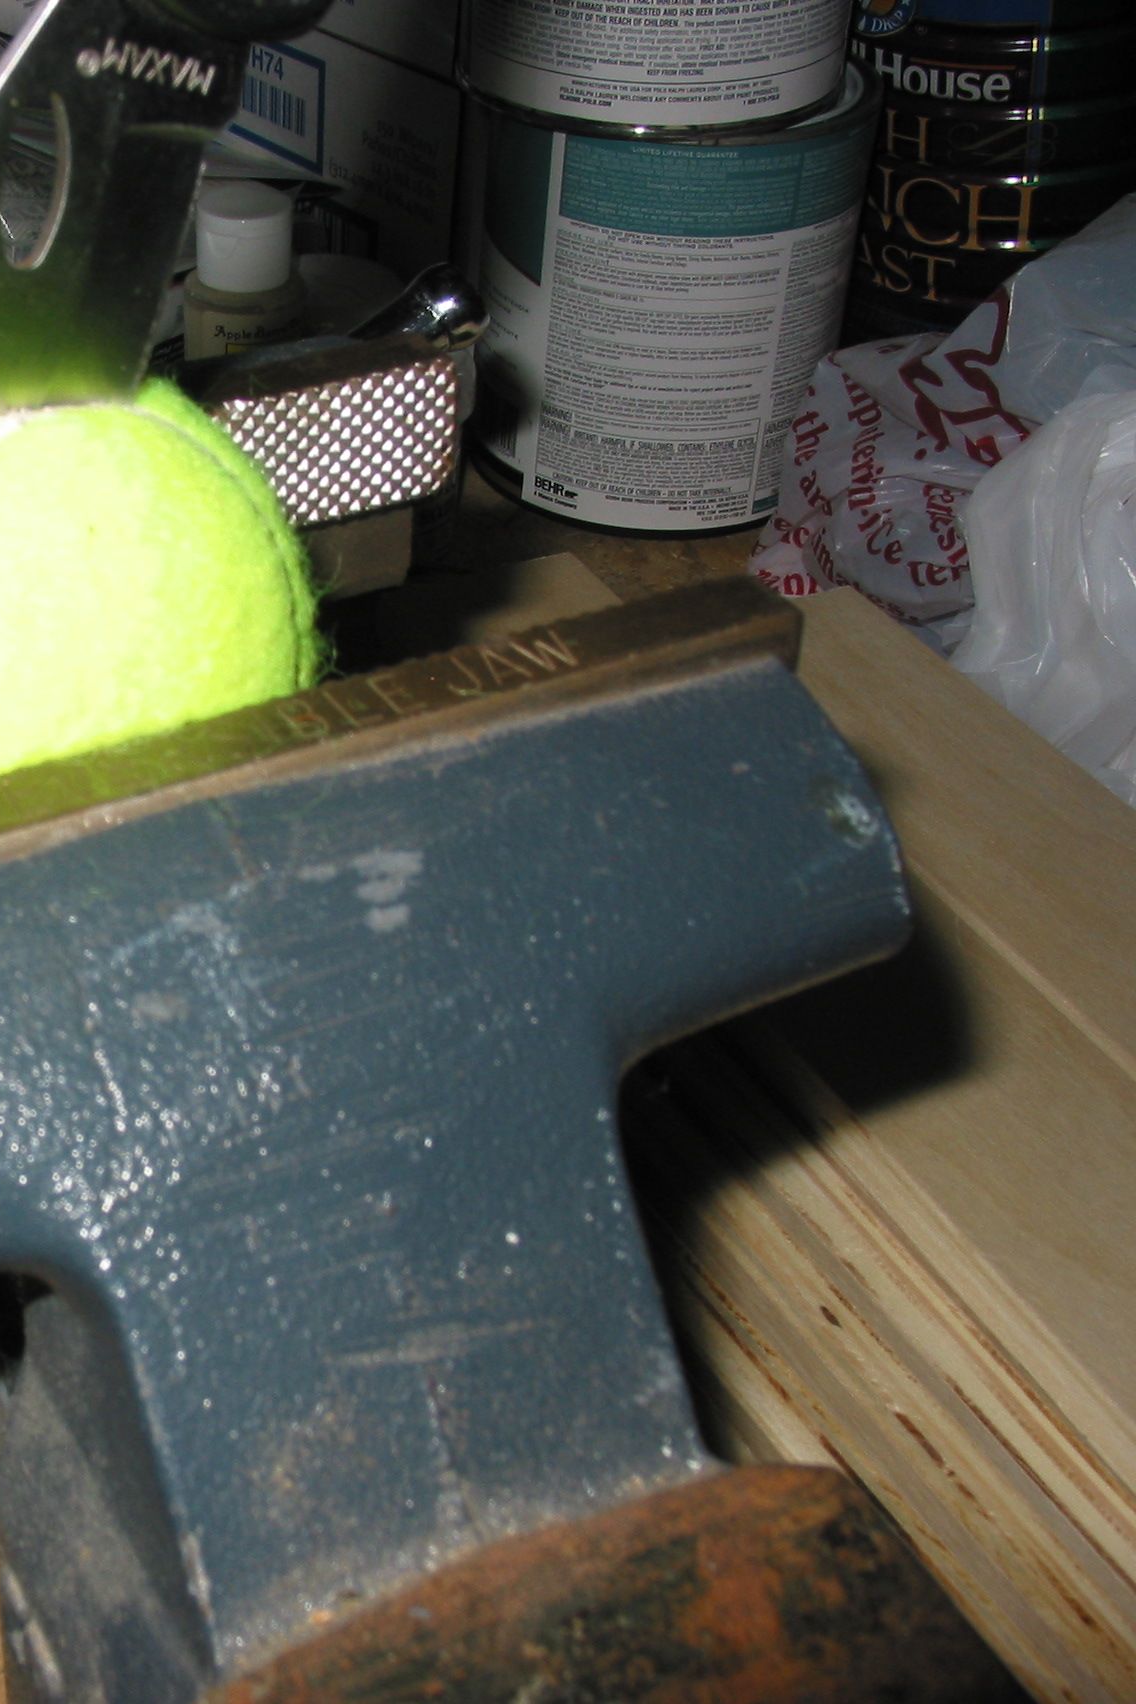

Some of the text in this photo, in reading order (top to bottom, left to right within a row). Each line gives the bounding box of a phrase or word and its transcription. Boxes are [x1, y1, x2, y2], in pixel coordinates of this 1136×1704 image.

[553, 9, 570, 18] KEEP
[571, 12, 584, 20] OUT
[595, 14, 607, 23] THE
[608, 15, 632, 25] REACH
[633, 18, 643, 26] OF
[662, 8, 678, 16] AND
[679, 8, 695, 16] HAS
[696, 7, 713, 16] BEEN
[250, 44, 284, 81] H74
[875, 48, 1011, 102] House
[214, 325, 251, 341] Apple
[792, 411, 829, 466] the
[534, 475, 564, 498] BEHR
[446, 629, 581, 699] JAW
